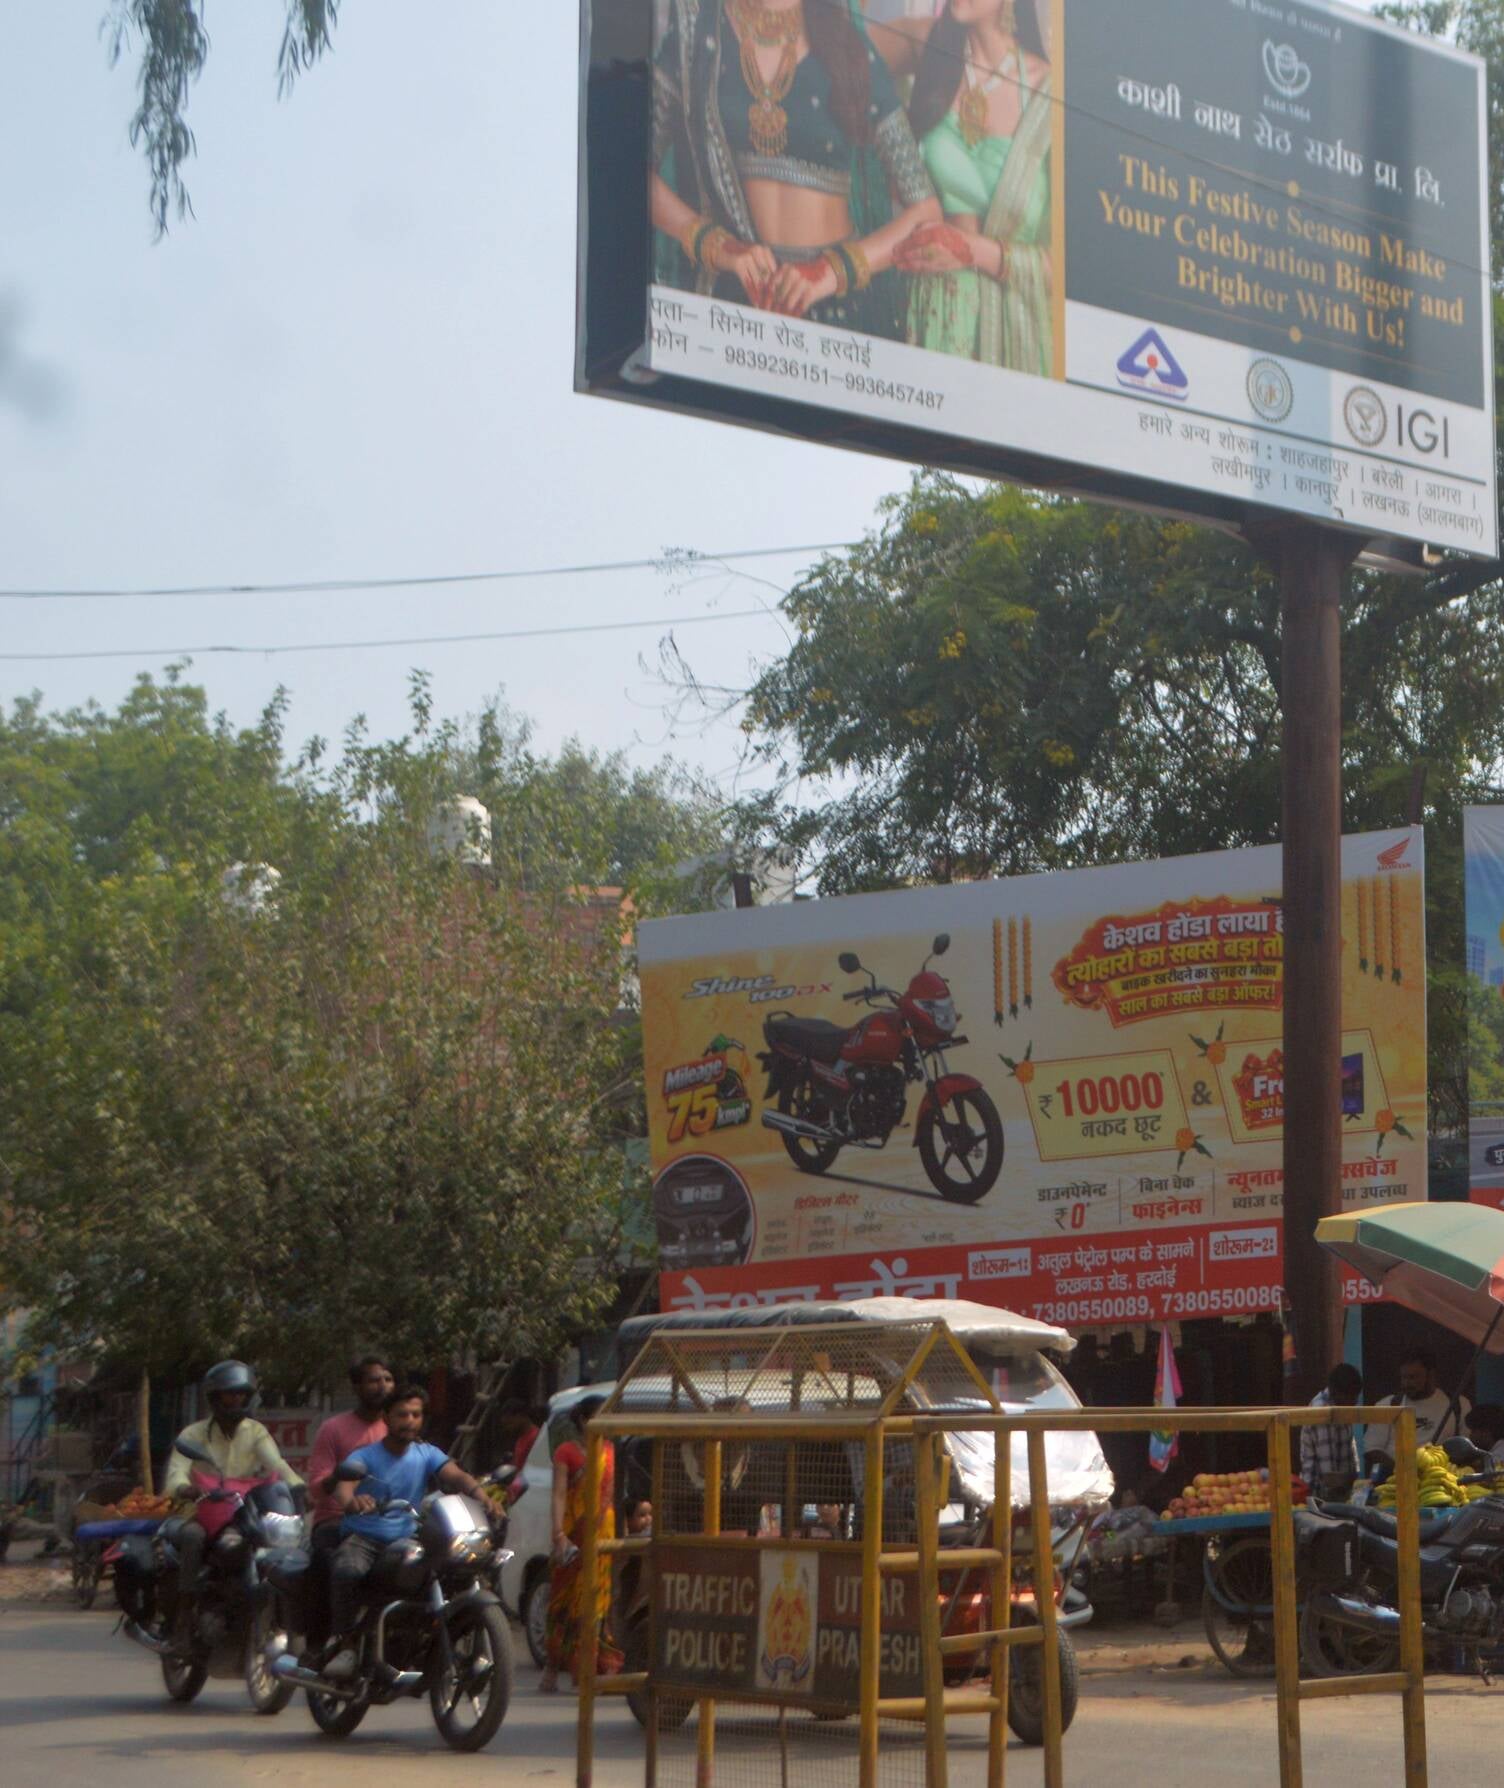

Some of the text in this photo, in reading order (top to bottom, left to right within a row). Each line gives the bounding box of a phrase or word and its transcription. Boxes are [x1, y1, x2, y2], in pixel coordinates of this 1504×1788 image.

[1117, 75, 1181, 120] काशी
[1194, 100, 1241, 140] नाथ
[1254, 114, 1291, 156] सेठ
[1375, 161, 1402, 193] प्रा.
[1415, 165, 1445, 208] लि.
[1118, 153, 1446, 281] This Festive Season Make
[1098, 190, 1464, 326] Your Celebration Bigger and
[1177, 256, 1405, 348] Brighter With Us!
[709, 304, 764, 340] सिनेमा
[778, 324, 810, 353] रोड,
[819, 336, 872, 368] हरदोई
[1397, 404, 1450, 459] IGI
[1138, 412, 1173, 435] हमारे
[1181, 423, 1210, 446] अन्य
[1371, 462, 1404, 491] बरेली
[1426, 481, 1462, 503] आगरा
[1210, 455, 1270, 489] लखीमपुर
[1295, 477, 1339, 506] कानपुर
[1361, 490, 1410, 517] लखनऊ
[1104, 911, 1268, 950] केशव होंडा लाया
[1139, 946, 1165, 968] का
[1169, 938, 1220, 963] सबसे
[1224, 936, 1259, 960] बड़ा
[682, 975, 776, 999] Shine
[1119, 999, 1147, 1016] साल
[1151, 995, 1168, 1009] का
[1172, 988, 1203, 1007] सबसे
[1208, 988, 1229, 1005] बड़ा
[1121, 974, 1151, 991] बाइक
[664, 1057, 724, 1091] Mileage
[1191, 1081, 1211, 1106] &
[667, 1087, 718, 1142] 75
[1082, 1115, 1161, 1142] नकद छूट
[1140, 1175, 1195, 1194] बिना चेक
[1132, 1196, 1203, 1221] फाइनेन्स
[1037, 1249, 1071, 1275] अतुल
[1074, 1246, 1108, 1275] पेट्रोल
[1112, 1244, 1136, 1263] पम्प
[1139, 1240, 1154, 1260] के
[1157, 1237, 1195, 1260] सामने
[1055, 1274, 1102, 1296] लखनऊ
[1136, 1265, 1177, 1290] हरदोई
[661, 1573, 754, 1615] TRAFFIC
[834, 1576, 905, 1616] UTAR
[666, 1629, 747, 1672] POLICE
[820, 1630, 920, 1674] PRAESH
